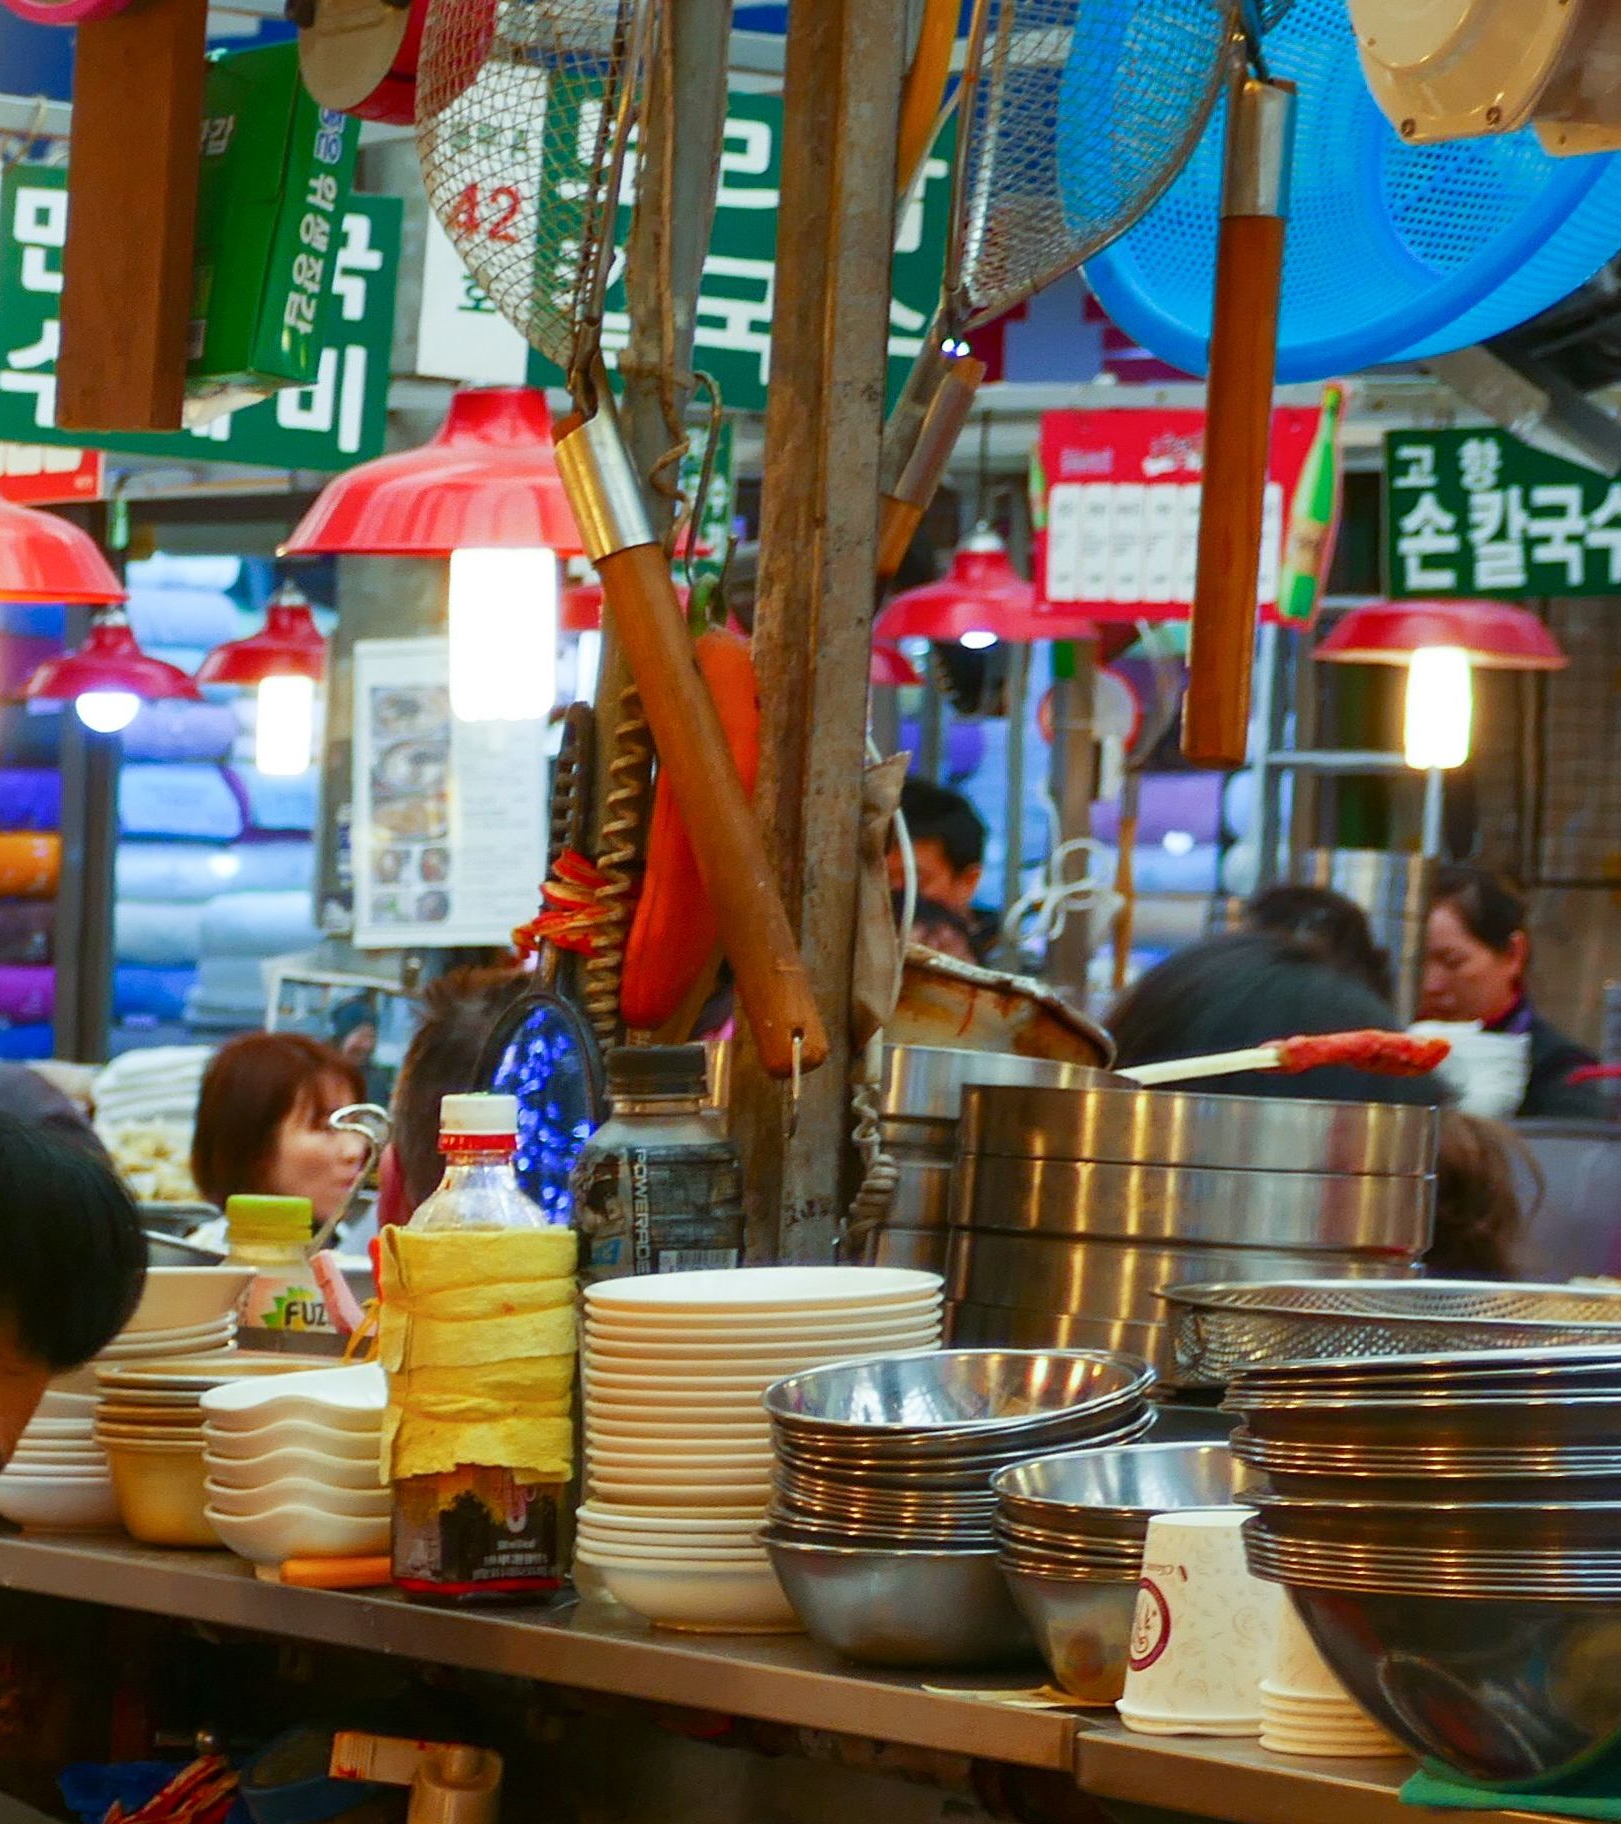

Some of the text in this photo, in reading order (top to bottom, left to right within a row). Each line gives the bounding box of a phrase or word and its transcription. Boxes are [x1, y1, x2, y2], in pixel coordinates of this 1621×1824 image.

[1397, 484, 1621, 589] 손칼국수
[634, 1147, 651, 1275] POWERADE
[284, 1301, 326, 1326] FUZ
